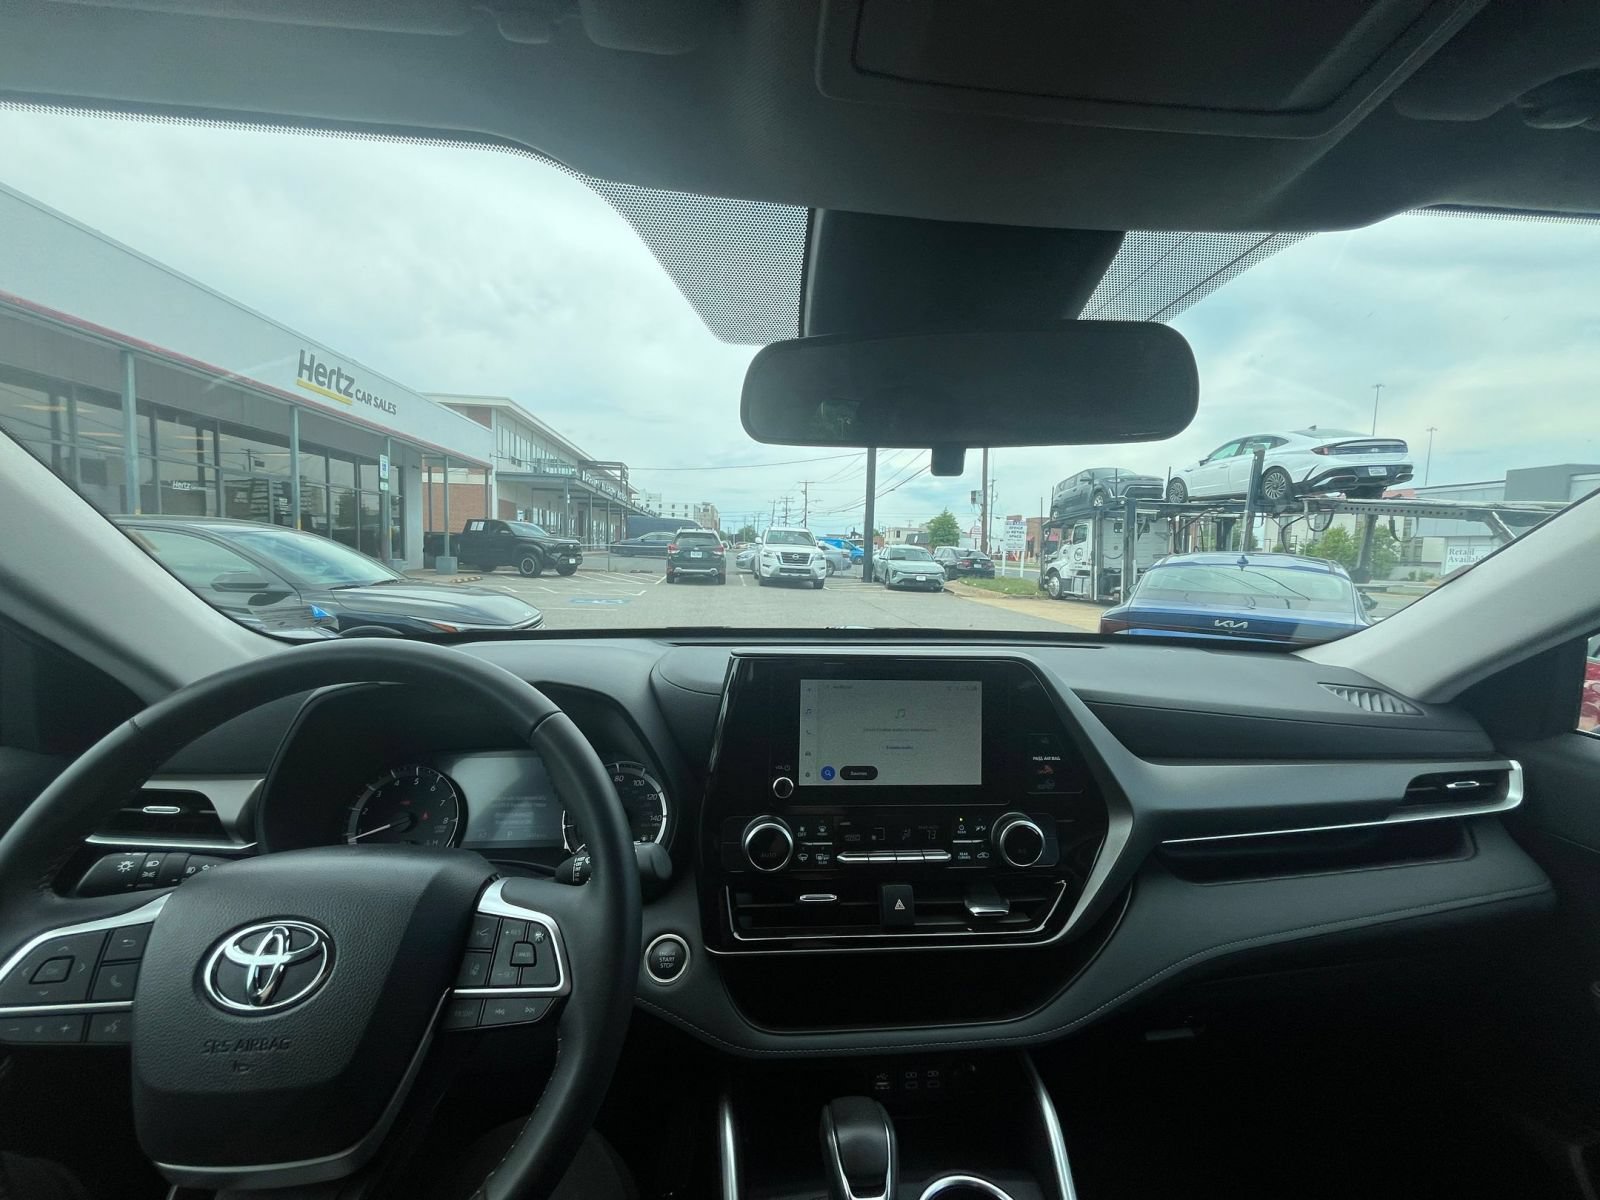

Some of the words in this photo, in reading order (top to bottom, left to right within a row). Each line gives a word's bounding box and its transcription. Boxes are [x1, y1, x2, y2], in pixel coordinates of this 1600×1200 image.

[298, 349, 355, 398] Hertz
[356, 389, 372, 406] CAR
[374, 397, 396, 415] SALES
[1449, 548, 1475, 556] Retail
[202, 1039, 232, 1055] SRS
[234, 1037, 292, 1052] AIRBAG
